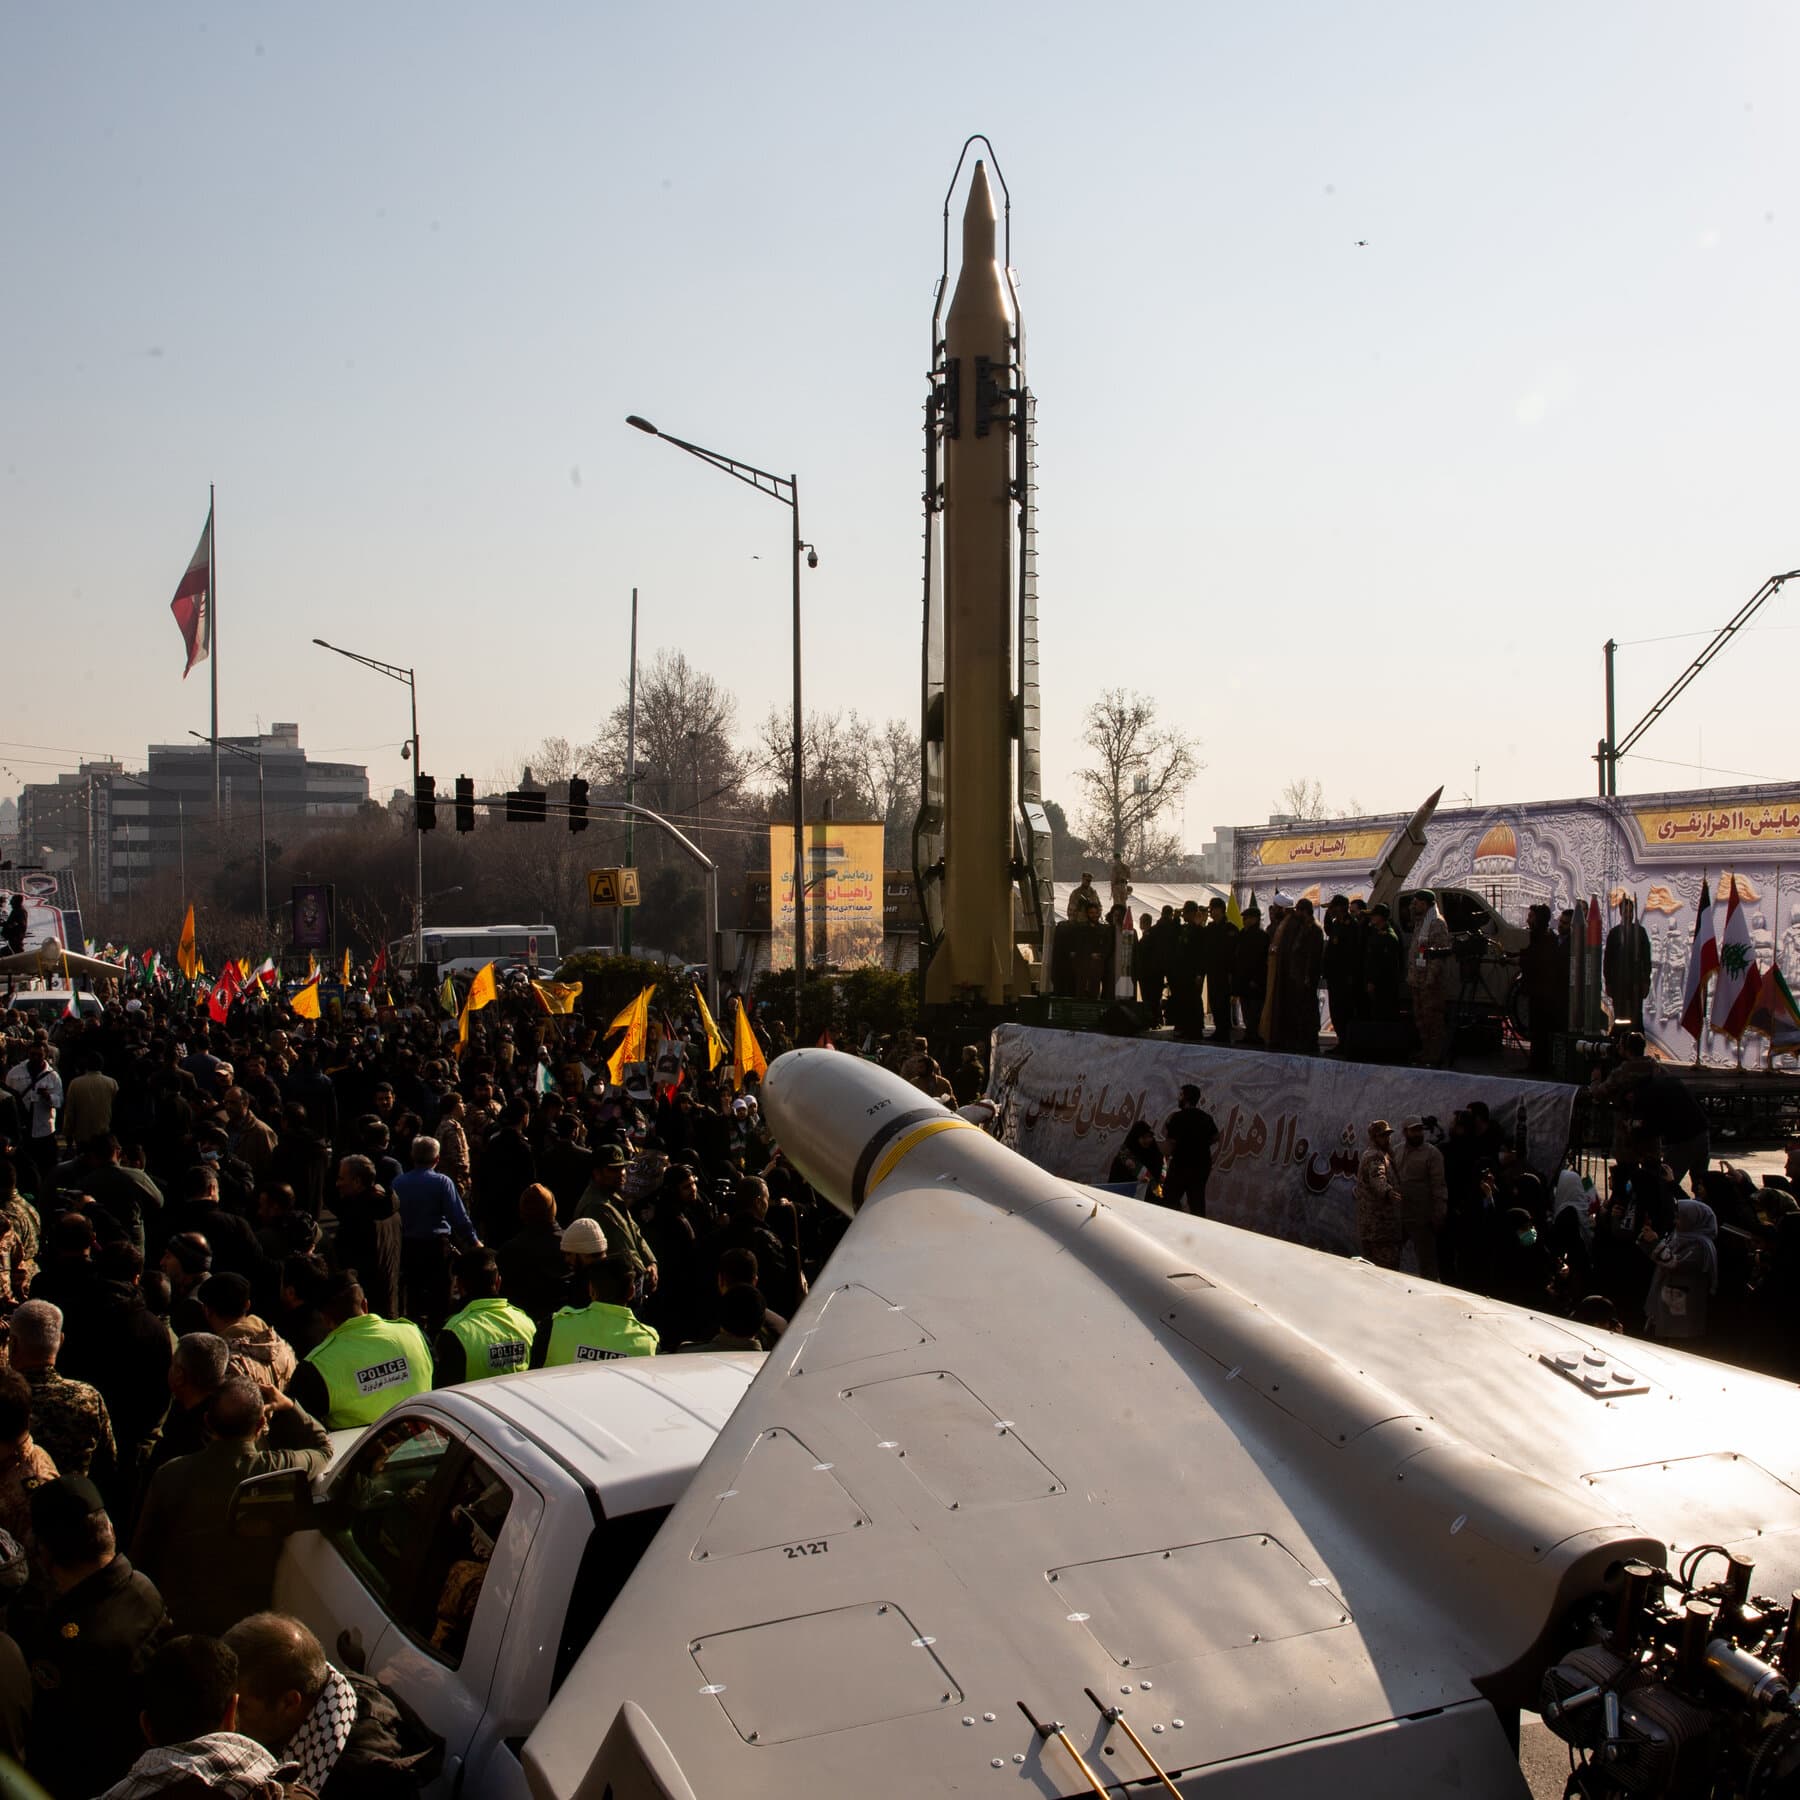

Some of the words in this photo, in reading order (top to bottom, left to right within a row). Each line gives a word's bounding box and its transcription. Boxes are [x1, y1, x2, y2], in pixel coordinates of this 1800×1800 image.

[1749, 807, 1800, 838] مایش
[1289, 837, 1314, 861] قدس
[1313, 838, 1346, 858] راهیان
[826, 885, 874, 903] راهیان
[866, 1098, 891, 1115] 2127
[1025, 1071, 1084, 1129] قدس
[491, 1345, 524, 1358] POLICE
[358, 1359, 406, 1382] POLICE
[783, 1541, 829, 1559] 2127
